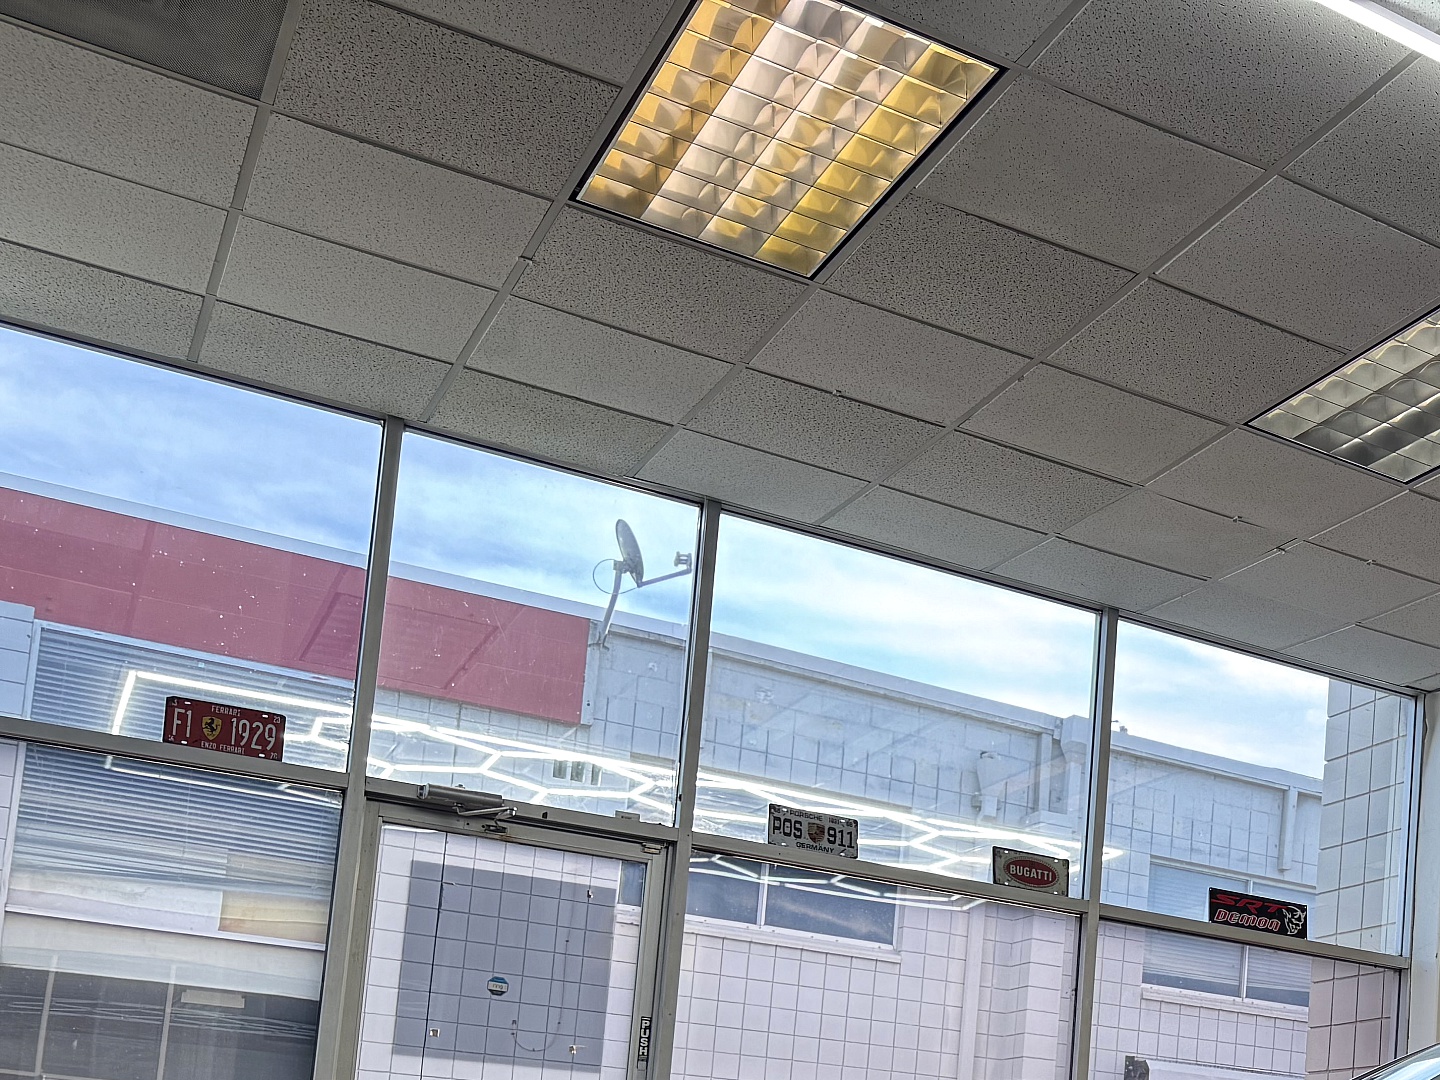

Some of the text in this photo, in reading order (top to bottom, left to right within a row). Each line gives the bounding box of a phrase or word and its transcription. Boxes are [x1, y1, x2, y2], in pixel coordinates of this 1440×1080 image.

[211, 705, 242, 717] FERRARI
[172, 708, 277, 751] F1 1929
[201, 741, 246, 755] ENZO FERRARI
[789, 809, 823, 822] PORSCHE
[772, 815, 803, 839] POS
[826, 826, 855, 849] 911
[1009, 864, 1052, 881] BUGATTI
[1211, 894, 1289, 915] SRT
[639, 1020, 650, 1056] PUSH
